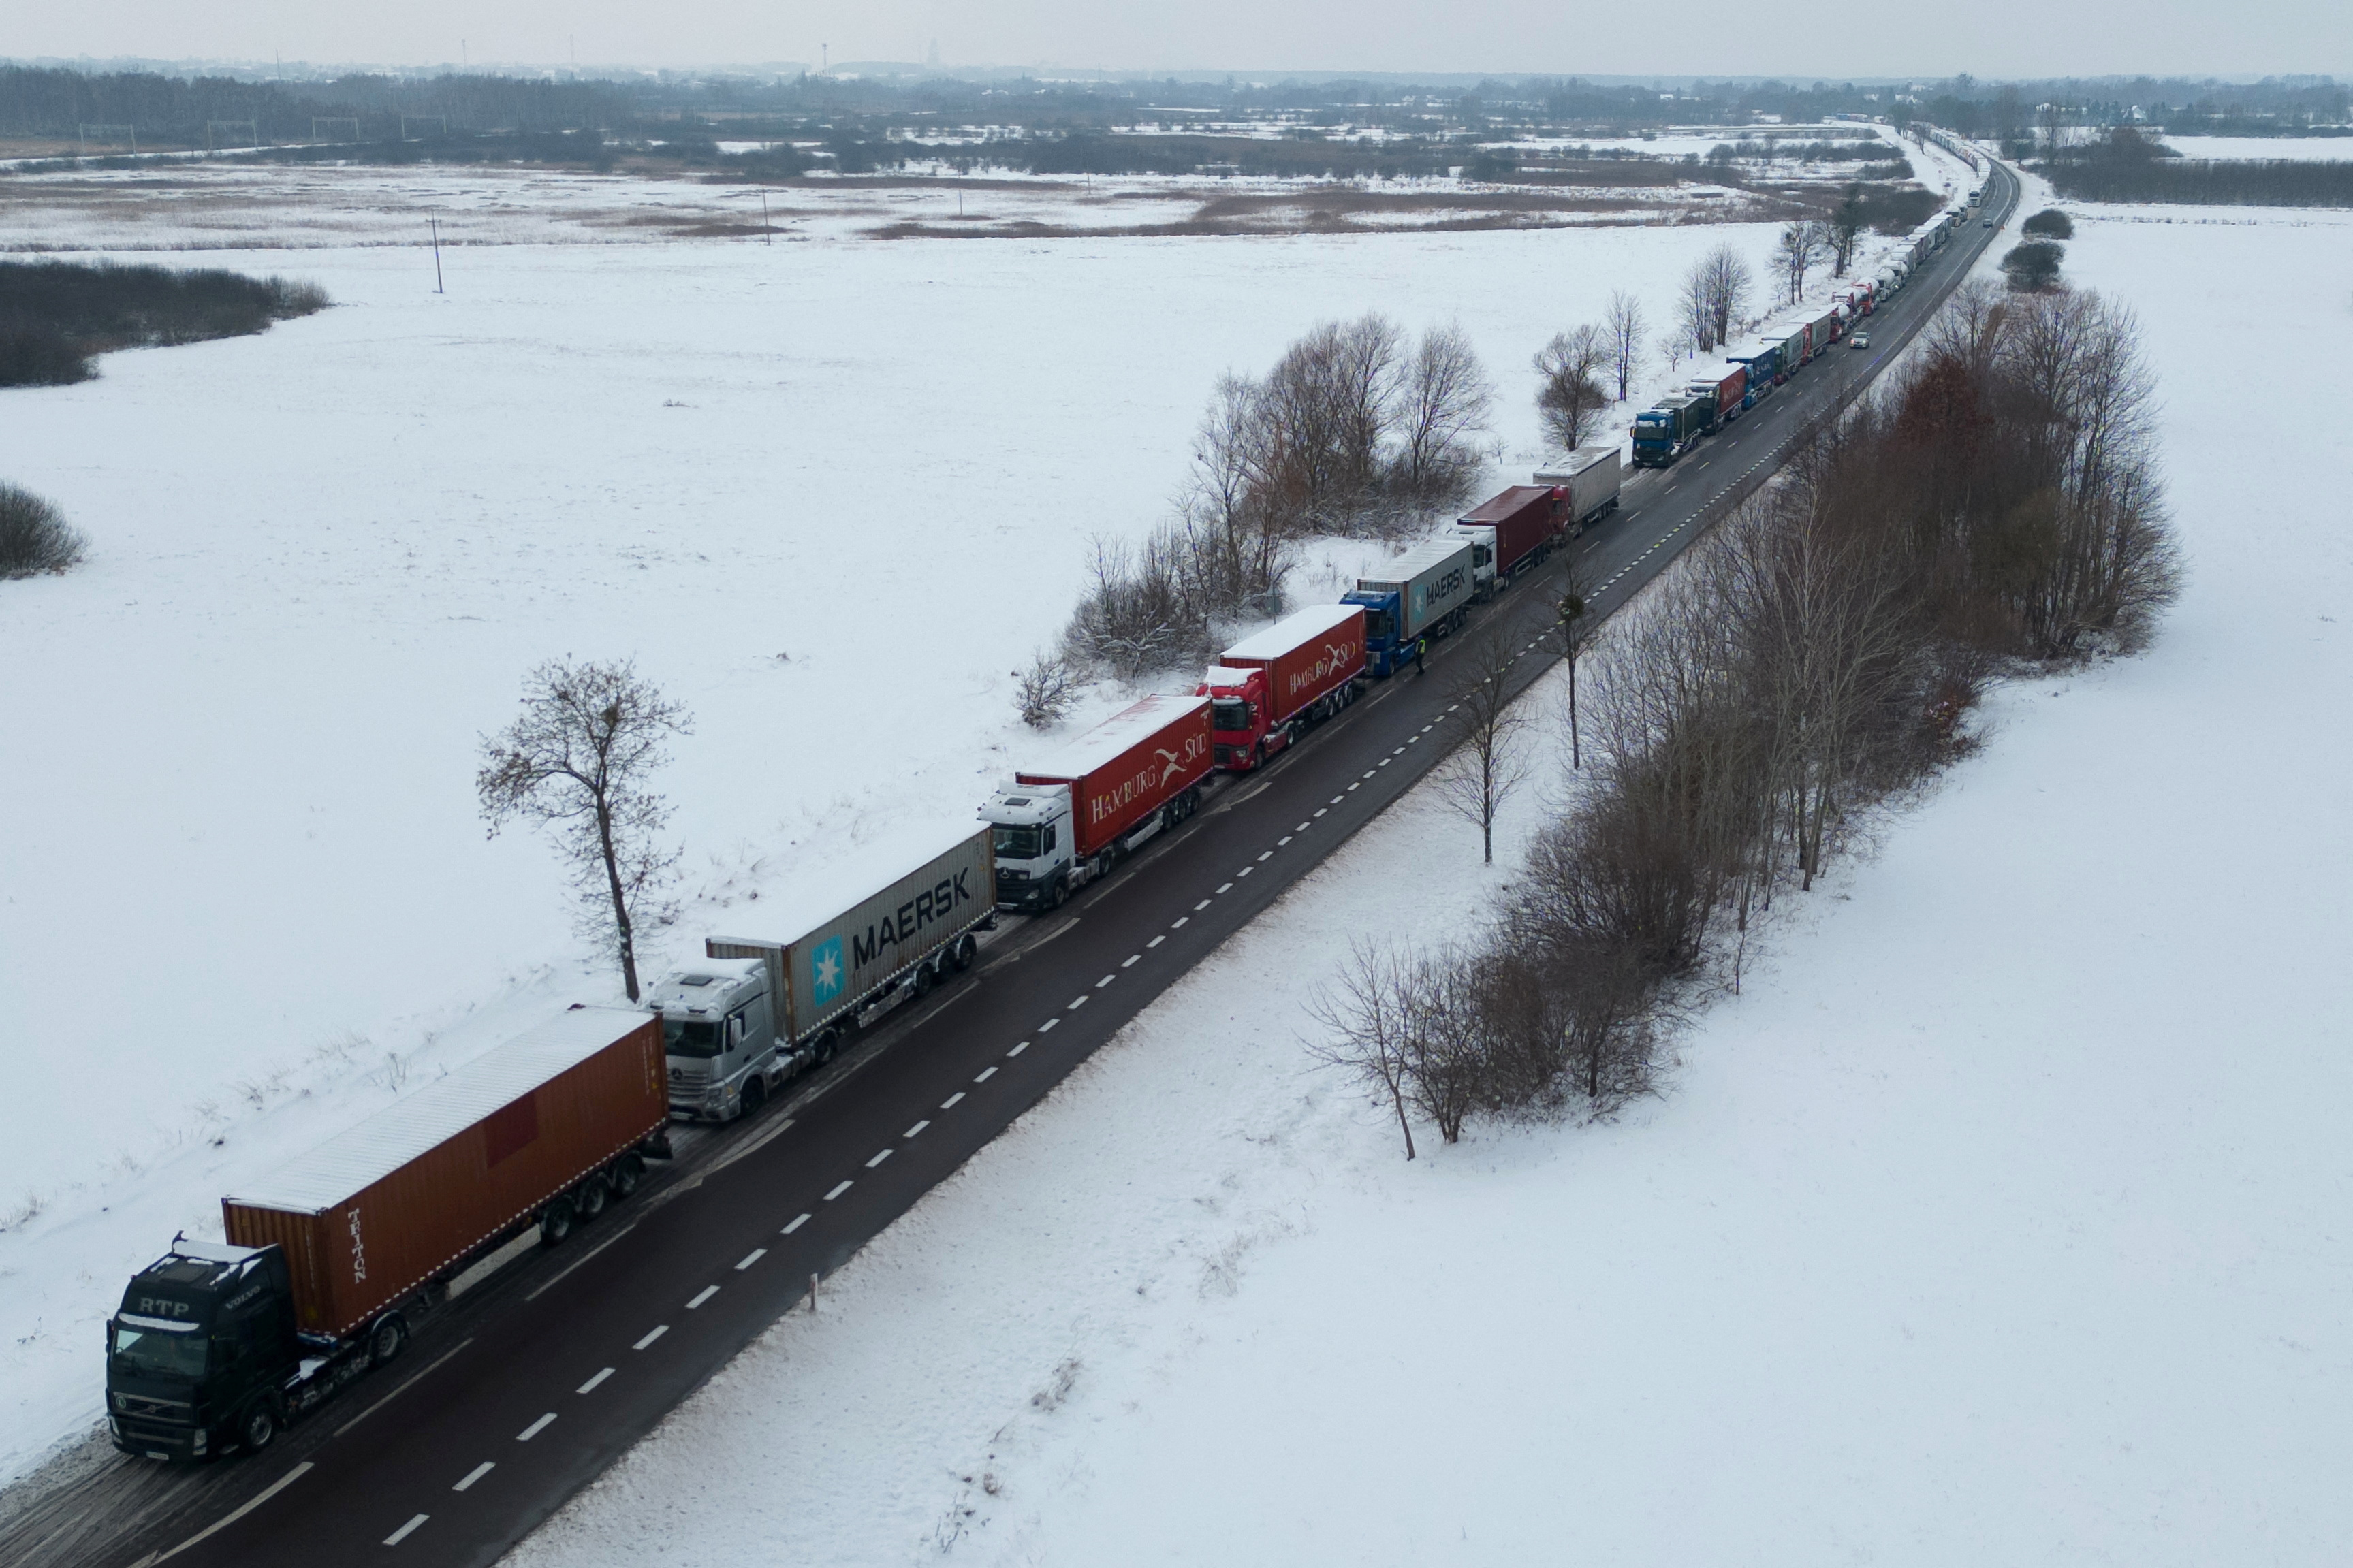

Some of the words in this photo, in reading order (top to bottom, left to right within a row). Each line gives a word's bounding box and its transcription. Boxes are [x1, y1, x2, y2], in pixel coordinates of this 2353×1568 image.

[1427, 564, 1465, 607] MAERSK
[1092, 765, 1156, 825] HAMBURG
[1185, 733, 1206, 763] SÜD
[853, 867, 970, 970] MAERSK
[348, 1208, 366, 1284] TRITON
[139, 1297, 189, 1316] RTP
[225, 1285, 261, 1309] VOLVO
